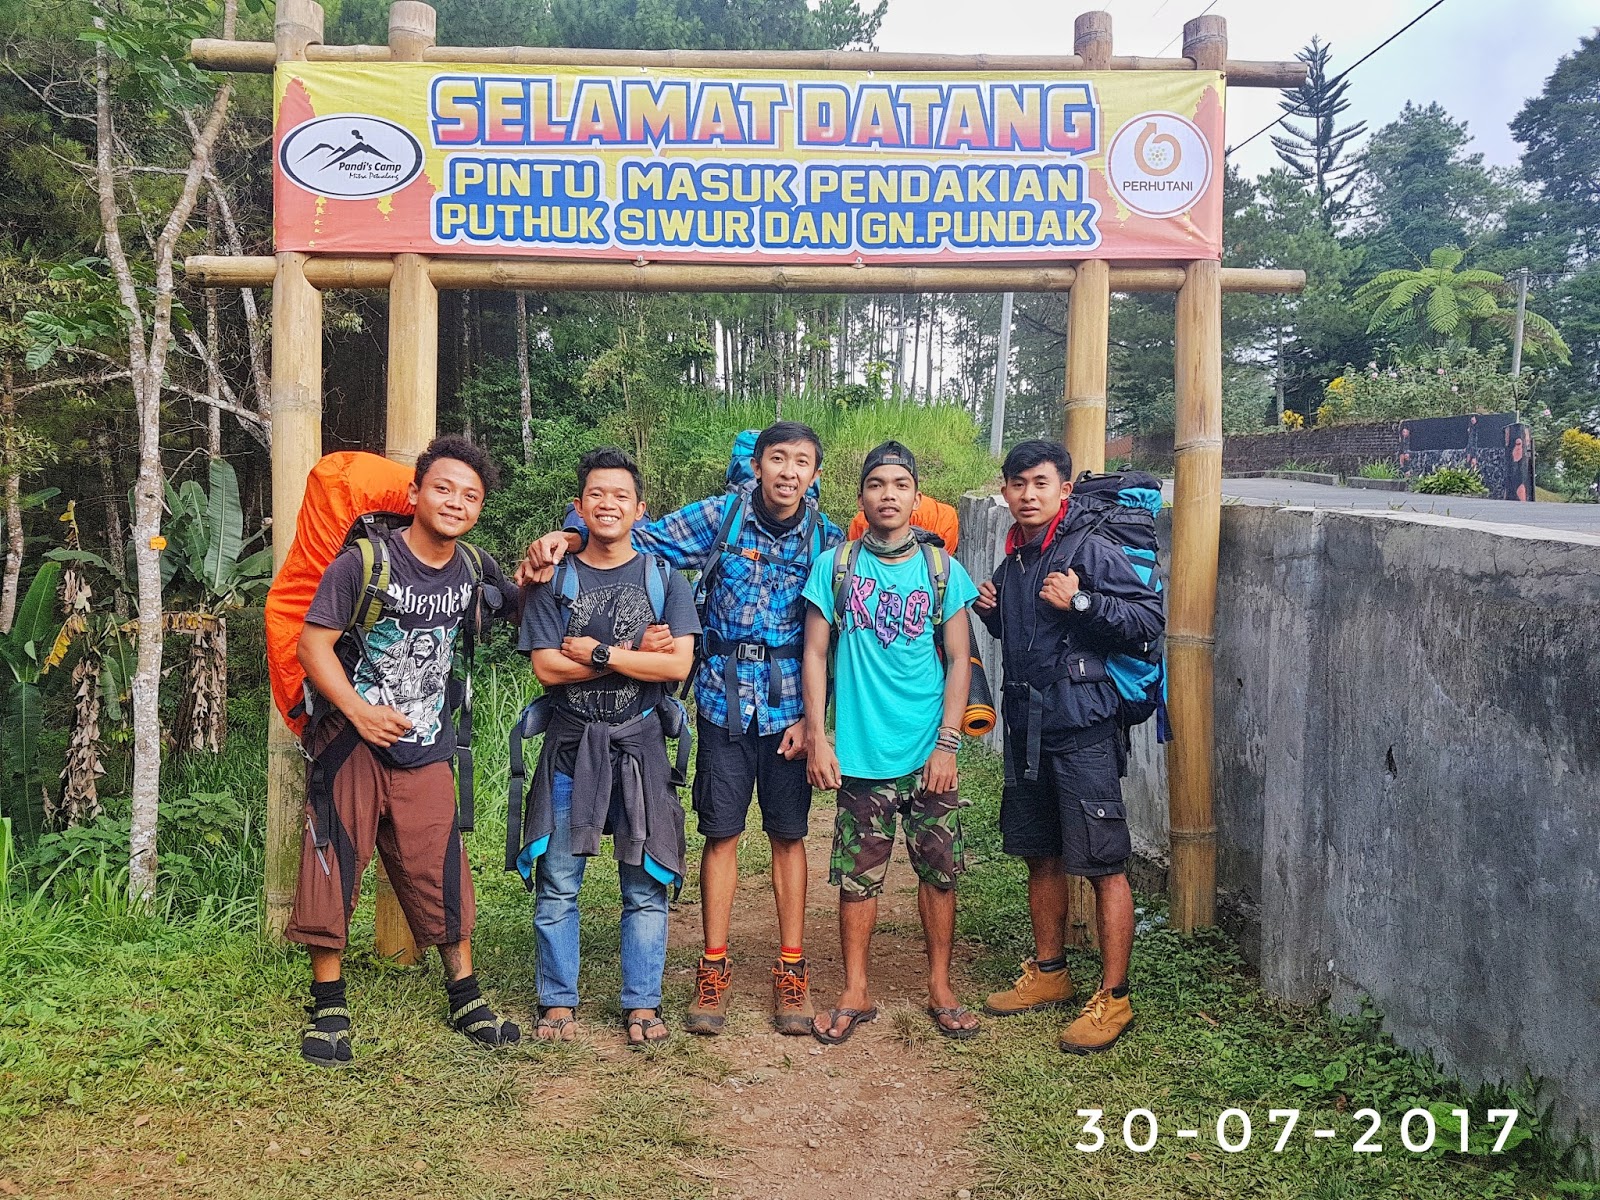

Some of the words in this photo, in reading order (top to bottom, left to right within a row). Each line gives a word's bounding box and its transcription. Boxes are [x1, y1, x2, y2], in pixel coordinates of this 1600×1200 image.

[433, 77, 787, 147] SELAMAT
[798, 84, 1096, 152] DATANG
[339, 162, 372, 171] Pandi's
[374, 162, 402, 173] Camp
[454, 162, 595, 198] PINTU
[628, 166, 792, 202] MASUK
[810, 169, 1079, 203] PENDAKIAN
[1123, 181, 1193, 191] PERHUTANI
[441, 203, 605, 240] PUTHUK
[619, 207, 750, 243] SIWUR
[765, 211, 847, 244] DAN
[862, 209, 1091, 245] GN.PUNDAK
